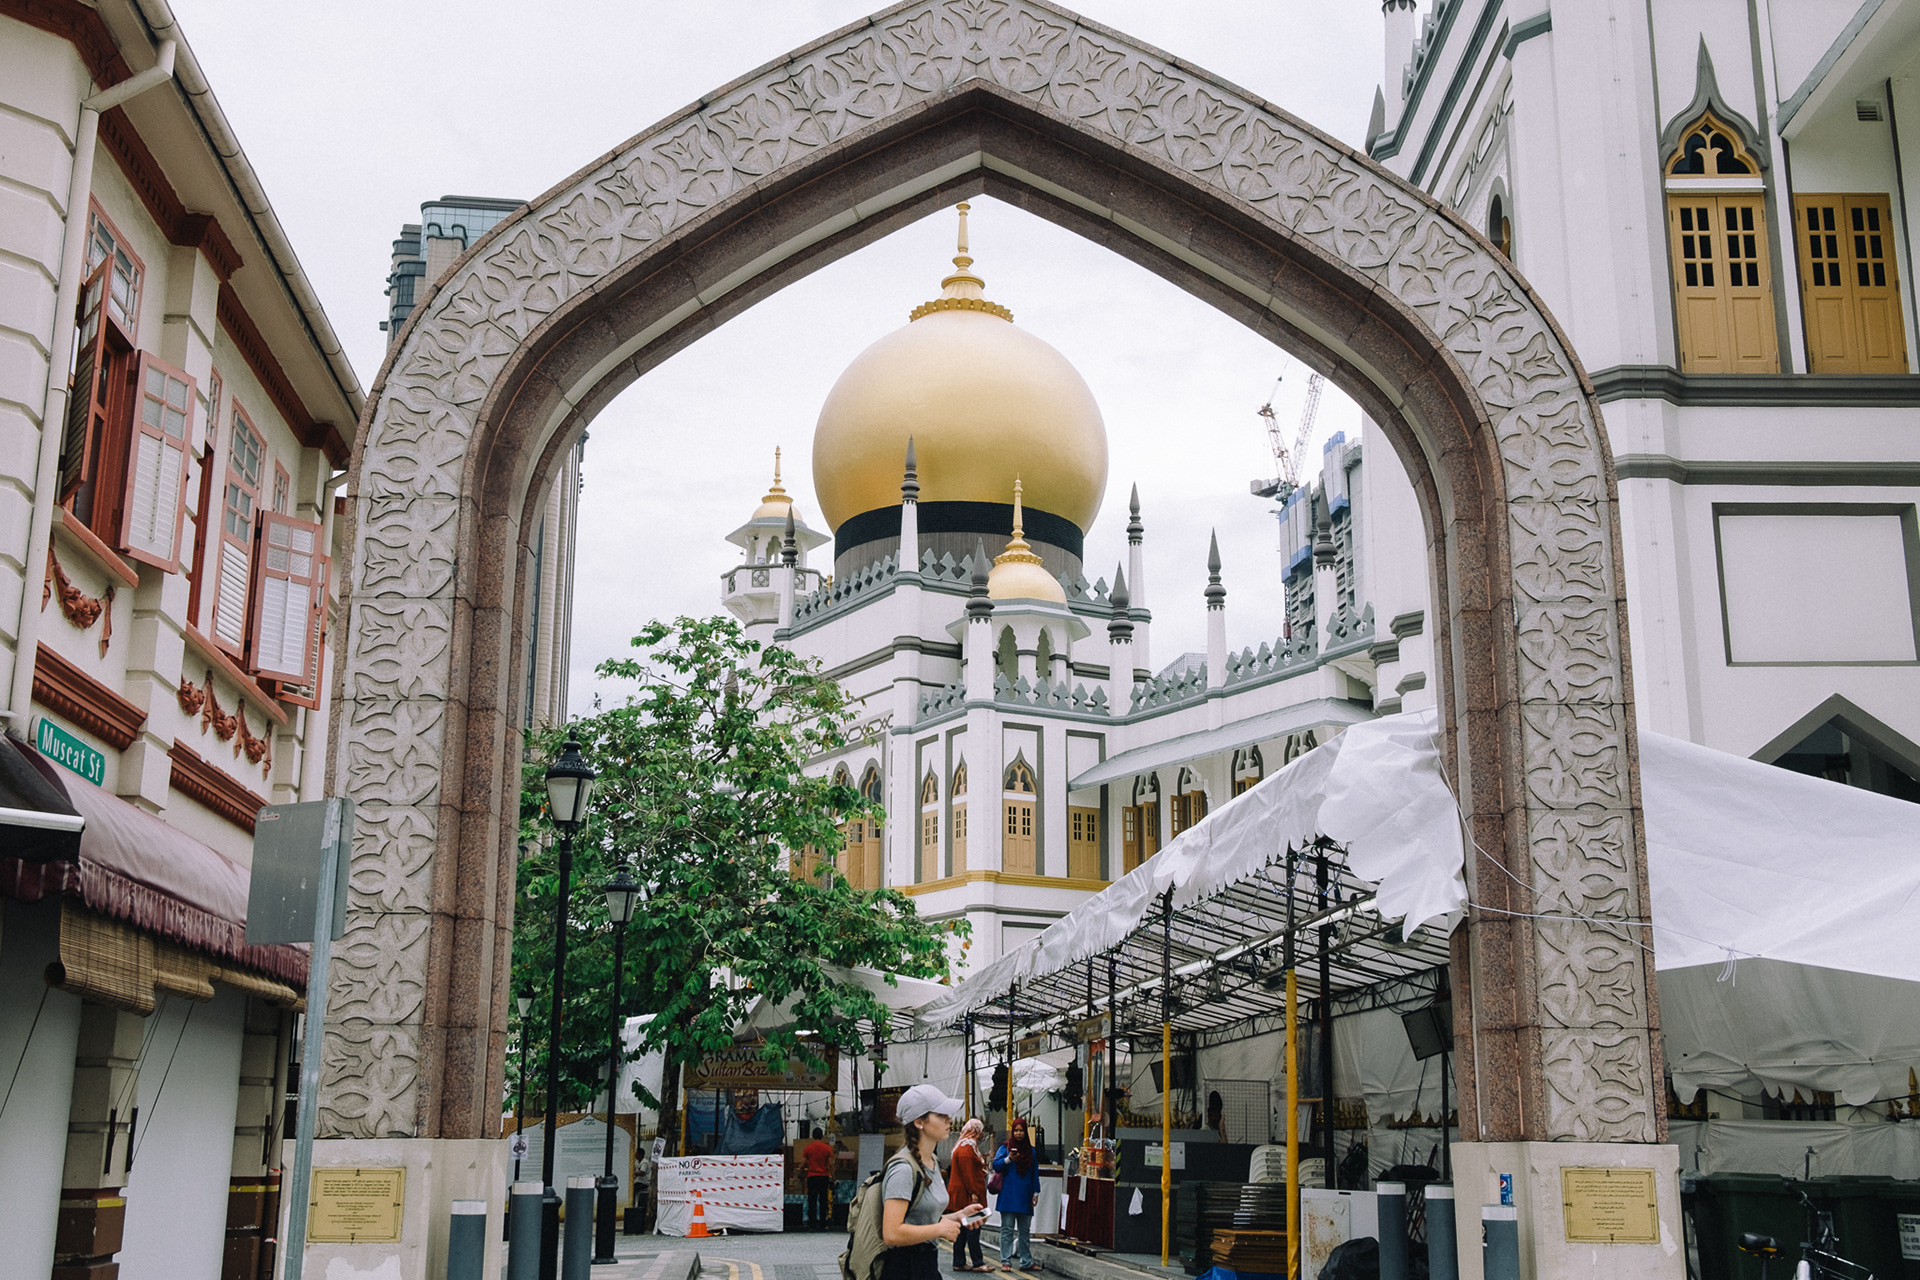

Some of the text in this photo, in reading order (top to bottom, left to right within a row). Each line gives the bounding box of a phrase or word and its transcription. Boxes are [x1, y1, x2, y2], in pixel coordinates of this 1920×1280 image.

[42, 724, 100, 782] Muscat St
[715, 1050, 790, 1061] RAMAN
[698, 1057, 741, 1078] Sultan
[742, 1060, 784, 1077] Baz
[678, 1160, 690, 1169] NO
